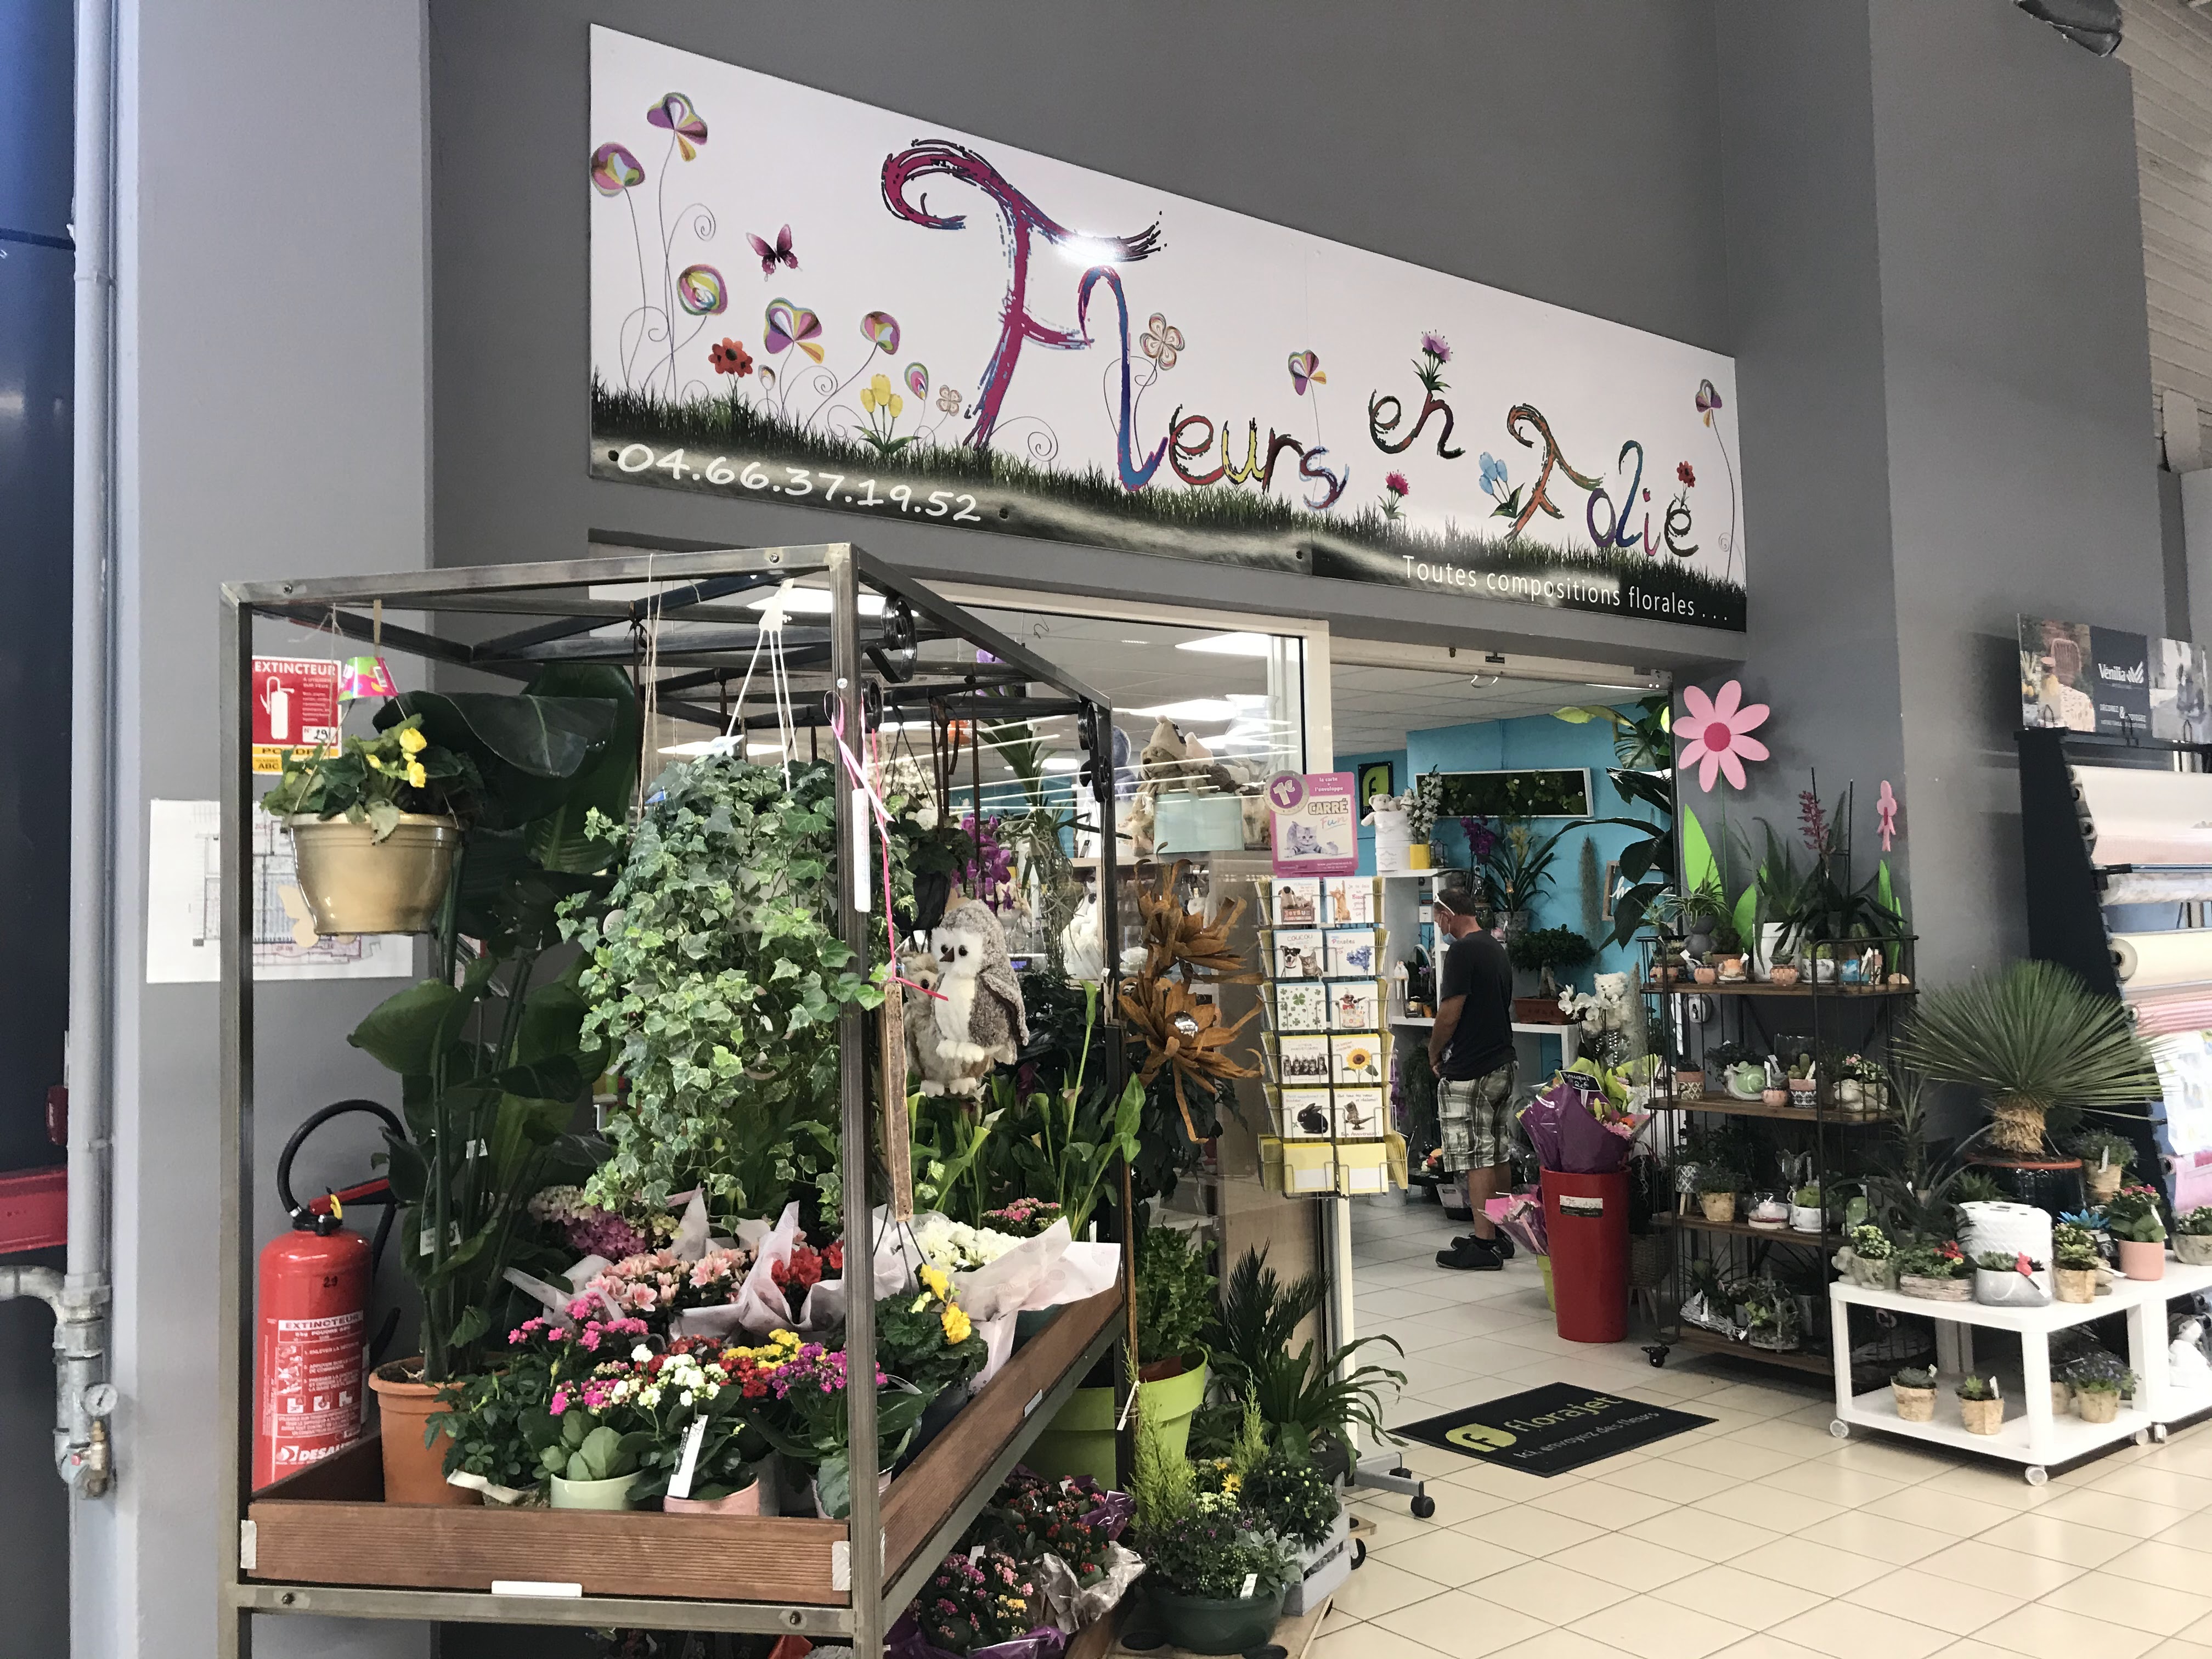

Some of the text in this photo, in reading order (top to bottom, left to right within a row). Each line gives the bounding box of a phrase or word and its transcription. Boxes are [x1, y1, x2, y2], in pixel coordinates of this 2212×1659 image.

[882, 139, 1699, 557] Fleurs en Folie
[617, 443, 981, 522] 04.66.37.19.52
[1403, 555, 1477, 586] Toutes
[1487, 571, 1620, 606] compositions
[1629, 586, 1694, 616] florales
[255, 661, 335, 676] EXTINCTEUR
[1308, 798, 1348, 815] CARRÉ
[1320, 816, 1347, 829] Fun
[285, 1314, 359, 1329] EXTINCTEUR
[1504, 1397, 1623, 1432] florajet
[1540, 1431, 1599, 1451] envoyez
